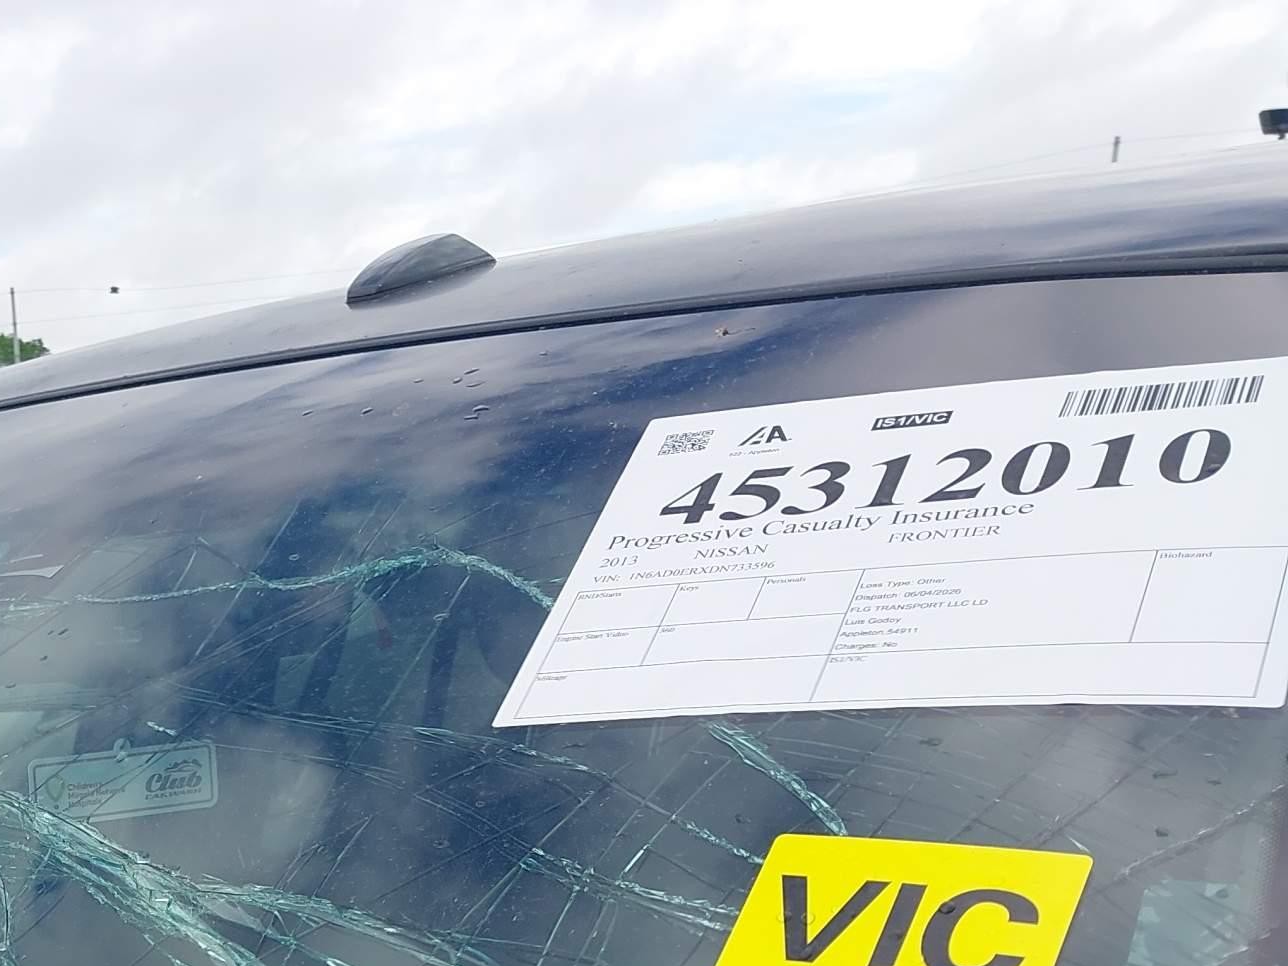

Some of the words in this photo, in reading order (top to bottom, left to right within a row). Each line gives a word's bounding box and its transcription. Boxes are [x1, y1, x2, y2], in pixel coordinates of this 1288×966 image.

[875, 412, 950, 429] IS1/VIC
[660, 429, 1232, 525] 45312010
[608, 525, 753, 550] Progressive
[762, 512, 881, 537] Casualty
[888, 503, 1035, 526] Insurance
[599, 555, 639, 569] 2013
[693, 543, 769, 560] NISSAN
[887, 525, 1001, 543] FRONTIER
[1159, 551, 1213, 559] Biohazard
[593, 574, 621, 584] VIN:
[629, 561, 776, 581] 1N6AD0ERXDN733596
[766, 576, 807, 585] Personals
[860, 582, 883, 590] Loss
[917, 577, 946, 586] Other
[679, 585, 700, 593] Keys
[904, 588, 962, 599] 06/04/2026
[850, 605, 872, 613] FLG
[874, 601, 945, 612] TRANSPORT
[947, 599, 969, 608] LLC
[972, 598, 989, 606] LD
[844, 618, 866, 626] Luis
[868, 616, 902, 626] Godoy
[886, 627, 919, 636] 54911
[881, 640, 899, 649] No
[144, 771, 203, 794] Club
